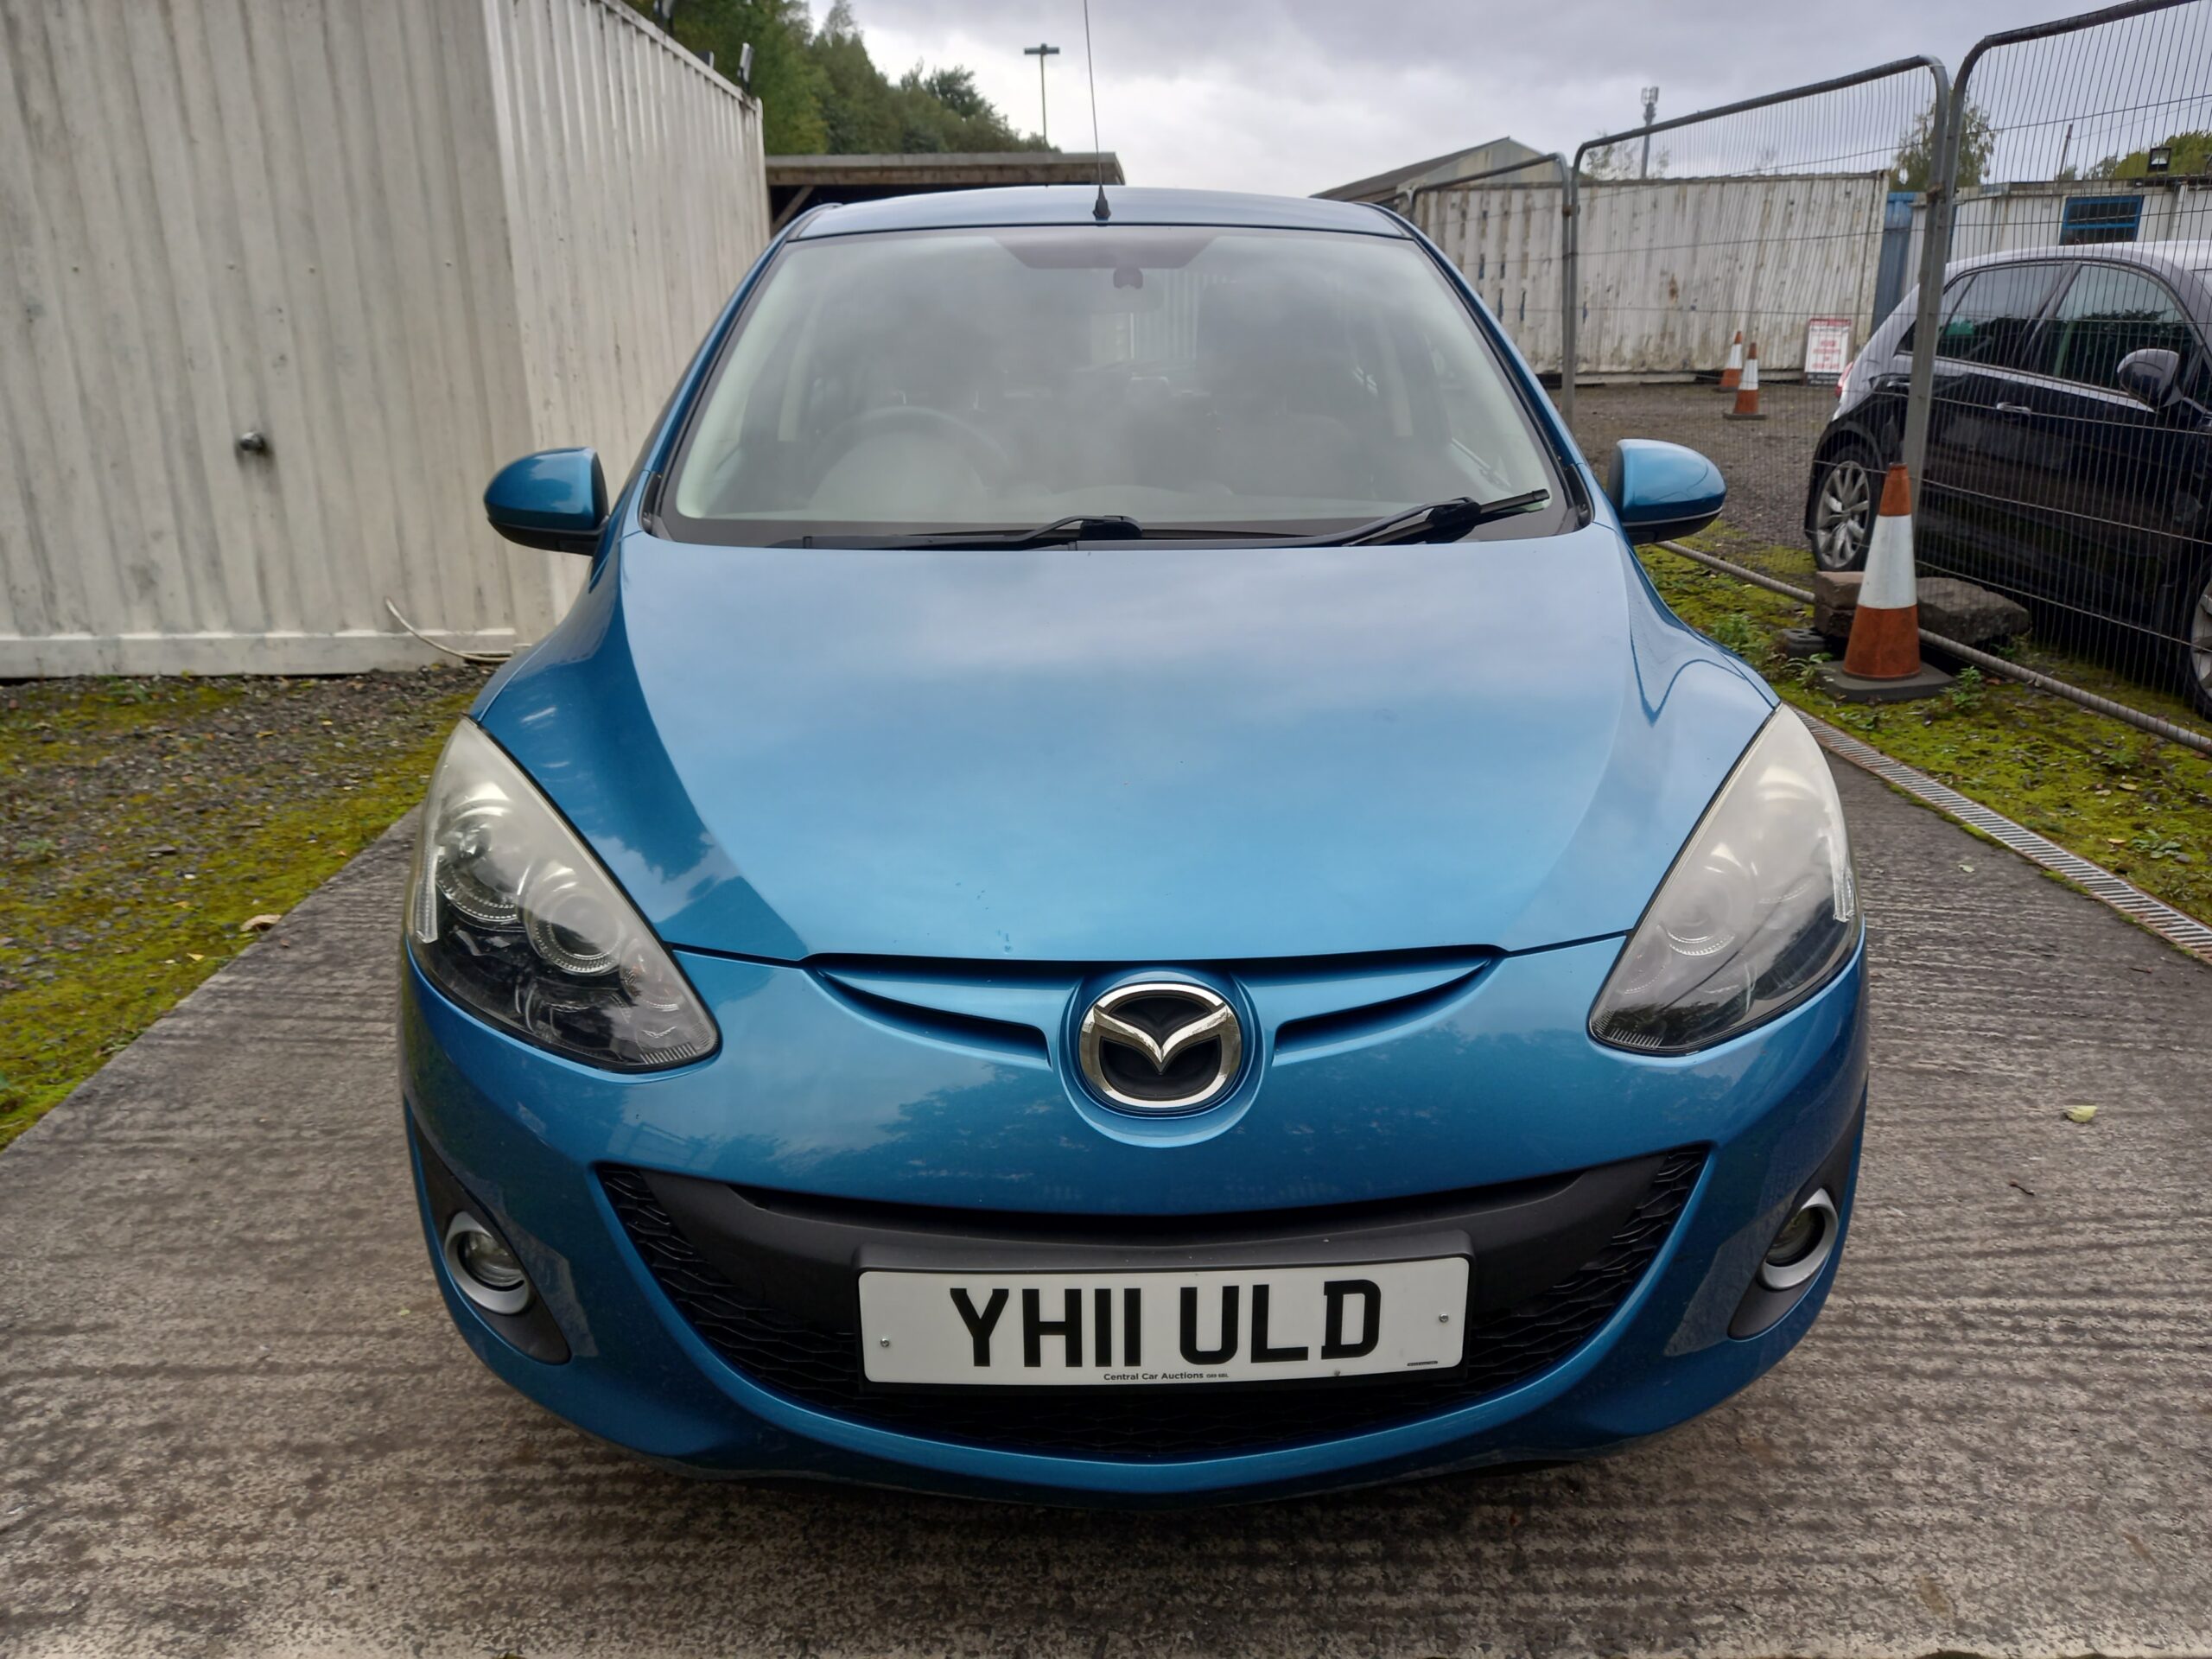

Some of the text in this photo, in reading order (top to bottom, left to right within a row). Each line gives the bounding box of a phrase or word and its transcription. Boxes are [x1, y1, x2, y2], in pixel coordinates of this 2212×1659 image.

[950, 1279, 1382, 1368] YH11 ULD
[1160, 1371, 1204, 1380] Auctions
